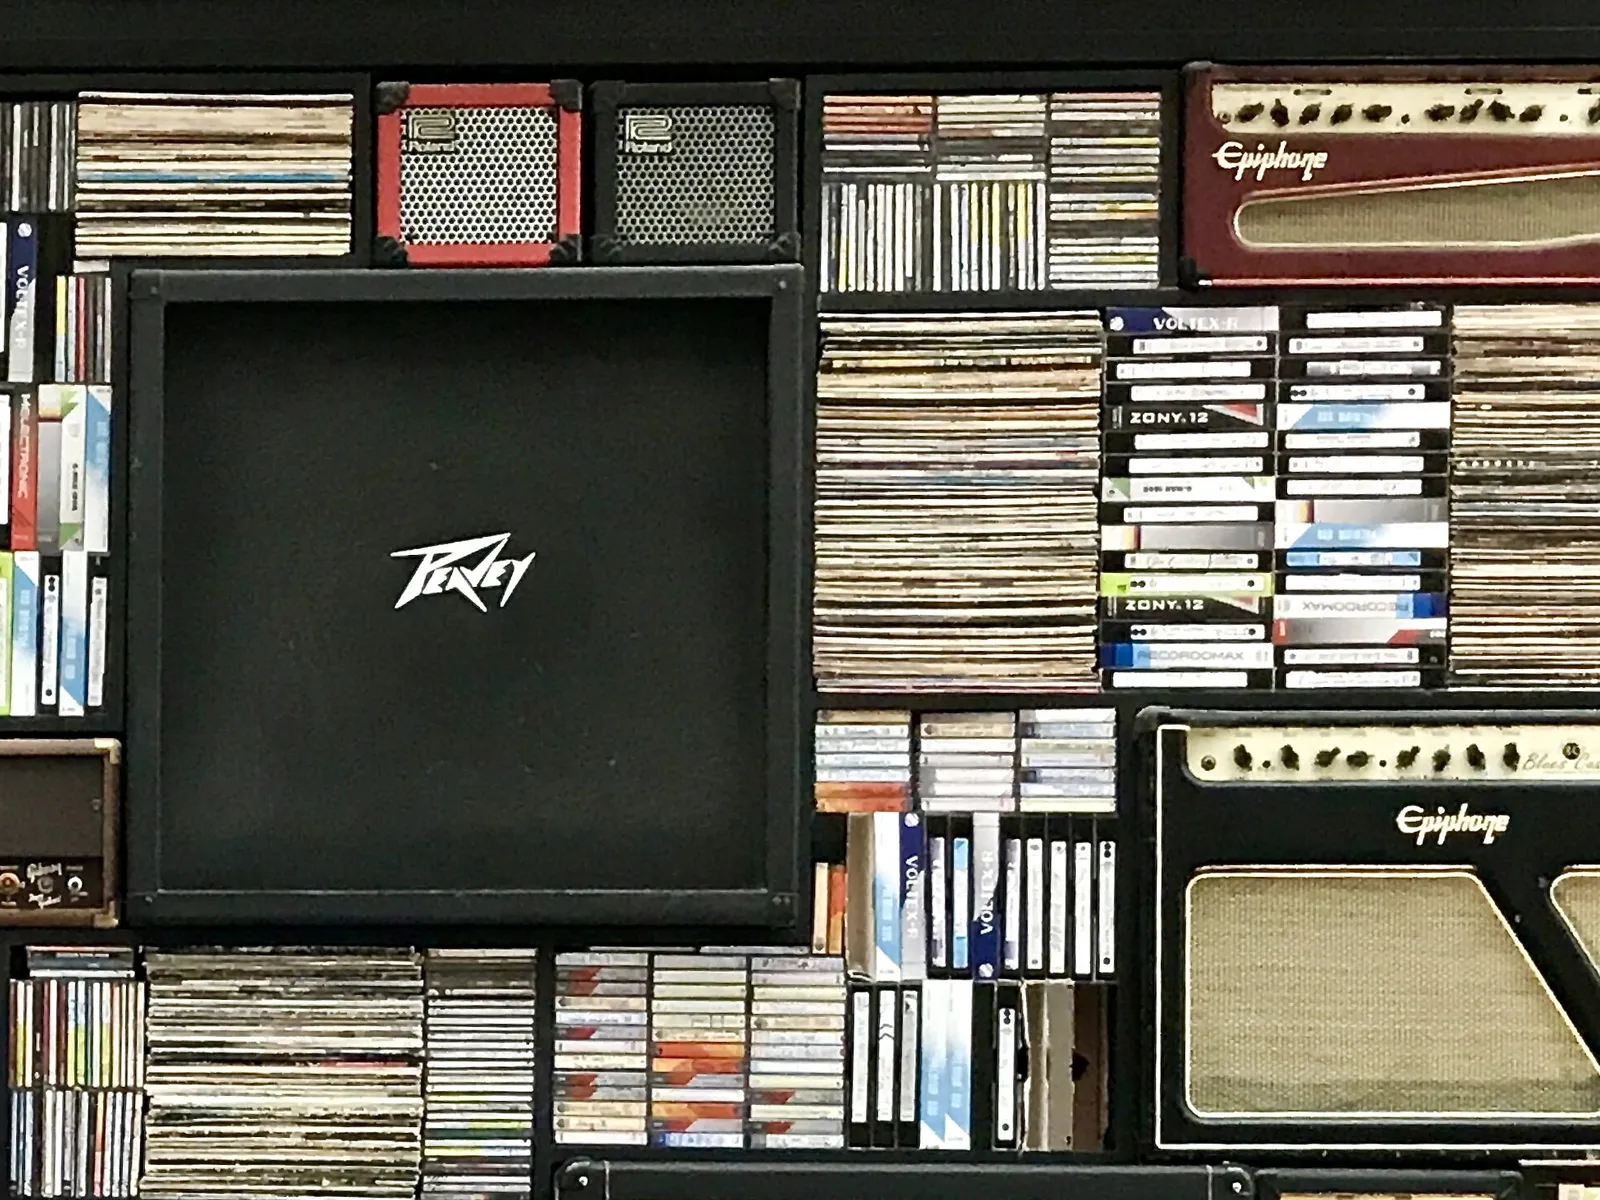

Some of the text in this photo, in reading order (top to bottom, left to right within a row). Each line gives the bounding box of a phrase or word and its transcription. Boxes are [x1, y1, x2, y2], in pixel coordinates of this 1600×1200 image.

[624, 140, 673, 154] Roland
[1212, 141, 1329, 182] Epiphone
[389, 531, 537, 613] PEAVEY
[1395, 803, 1511, 845] Epiphone
